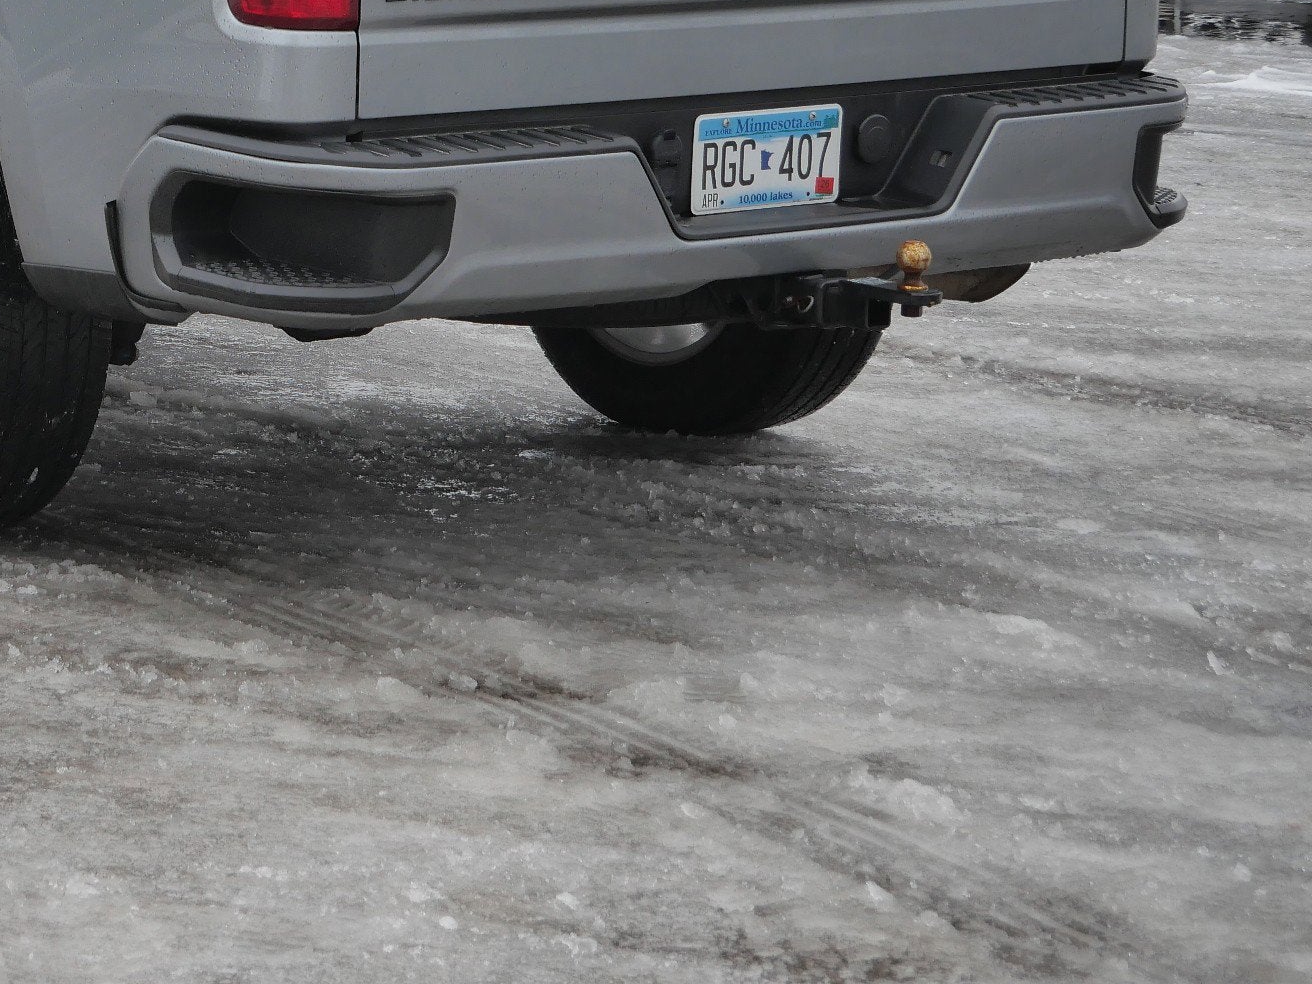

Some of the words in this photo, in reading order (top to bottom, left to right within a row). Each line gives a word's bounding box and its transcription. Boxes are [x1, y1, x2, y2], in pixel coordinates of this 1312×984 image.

[702, 139, 756, 190] RGC
[779, 131, 832, 181] 407
[701, 193, 719, 209] APR
[739, 193, 768, 205] 10,000
[769, 191, 794, 201] lakes
